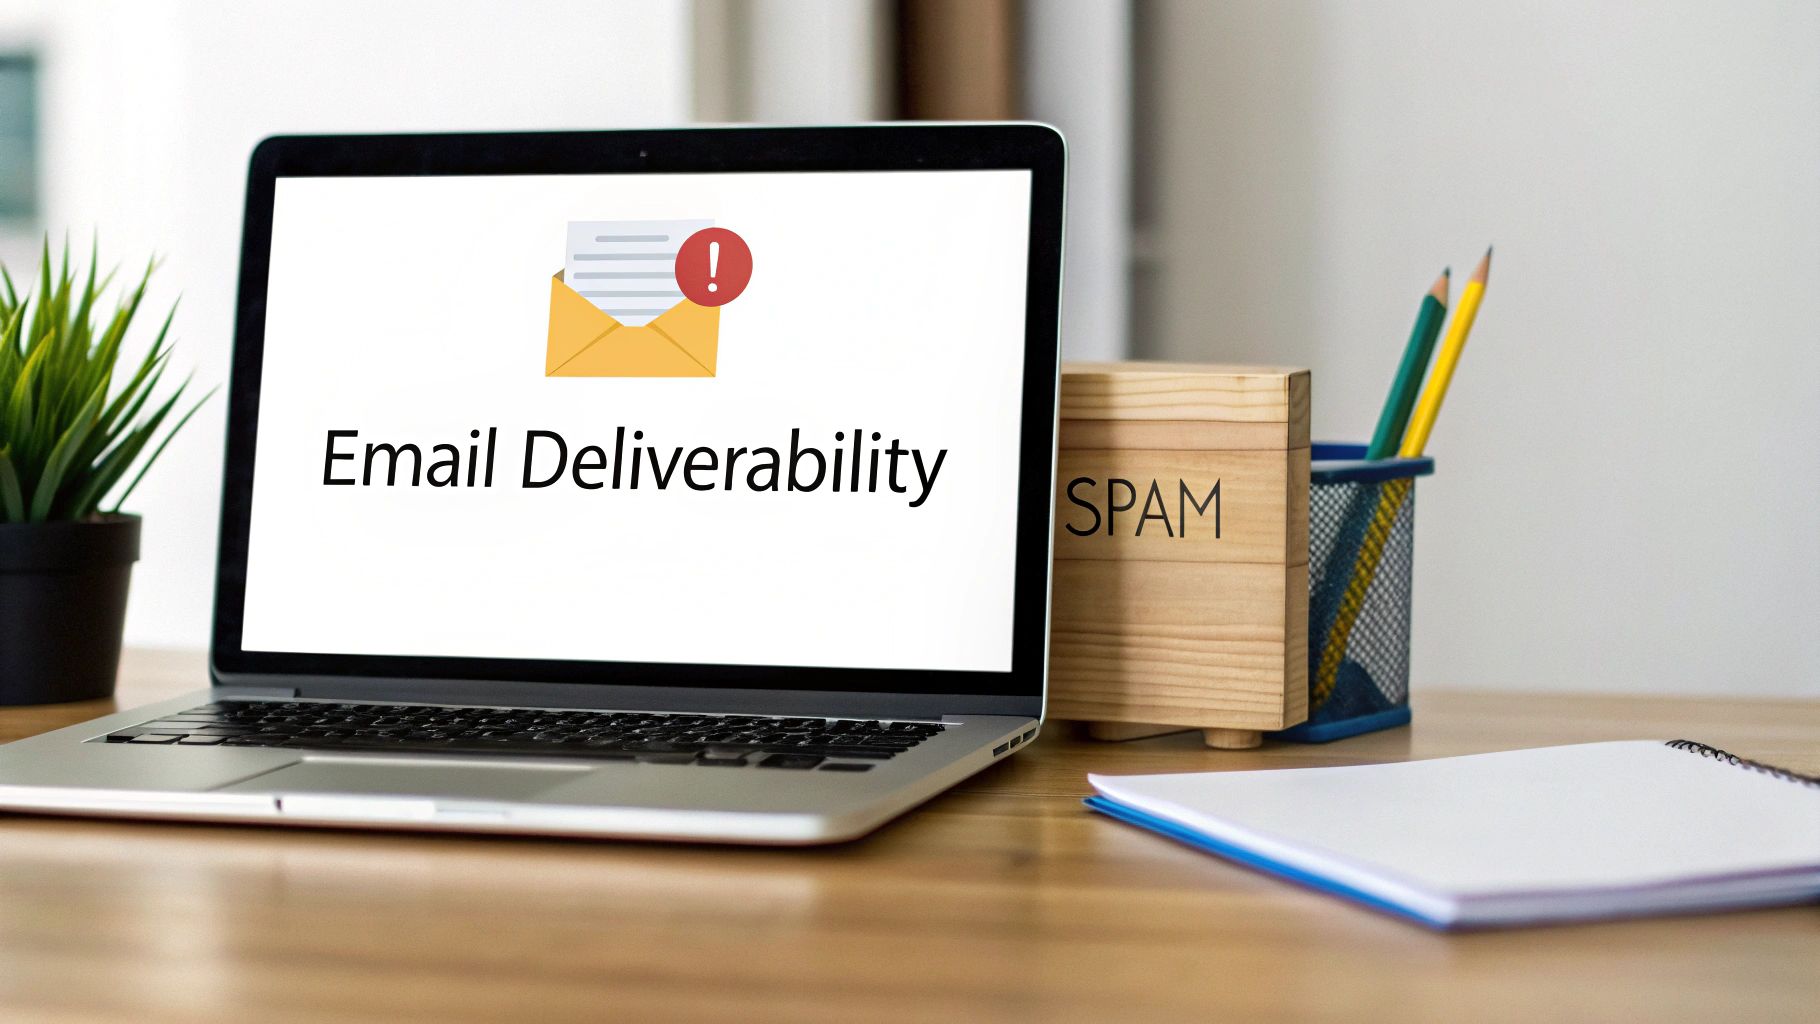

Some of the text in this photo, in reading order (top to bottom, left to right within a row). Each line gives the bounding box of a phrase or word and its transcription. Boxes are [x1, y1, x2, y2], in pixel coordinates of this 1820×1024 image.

[322, 426, 948, 508] Email Deliverability
[1065, 477, 1221, 539] SPAM
